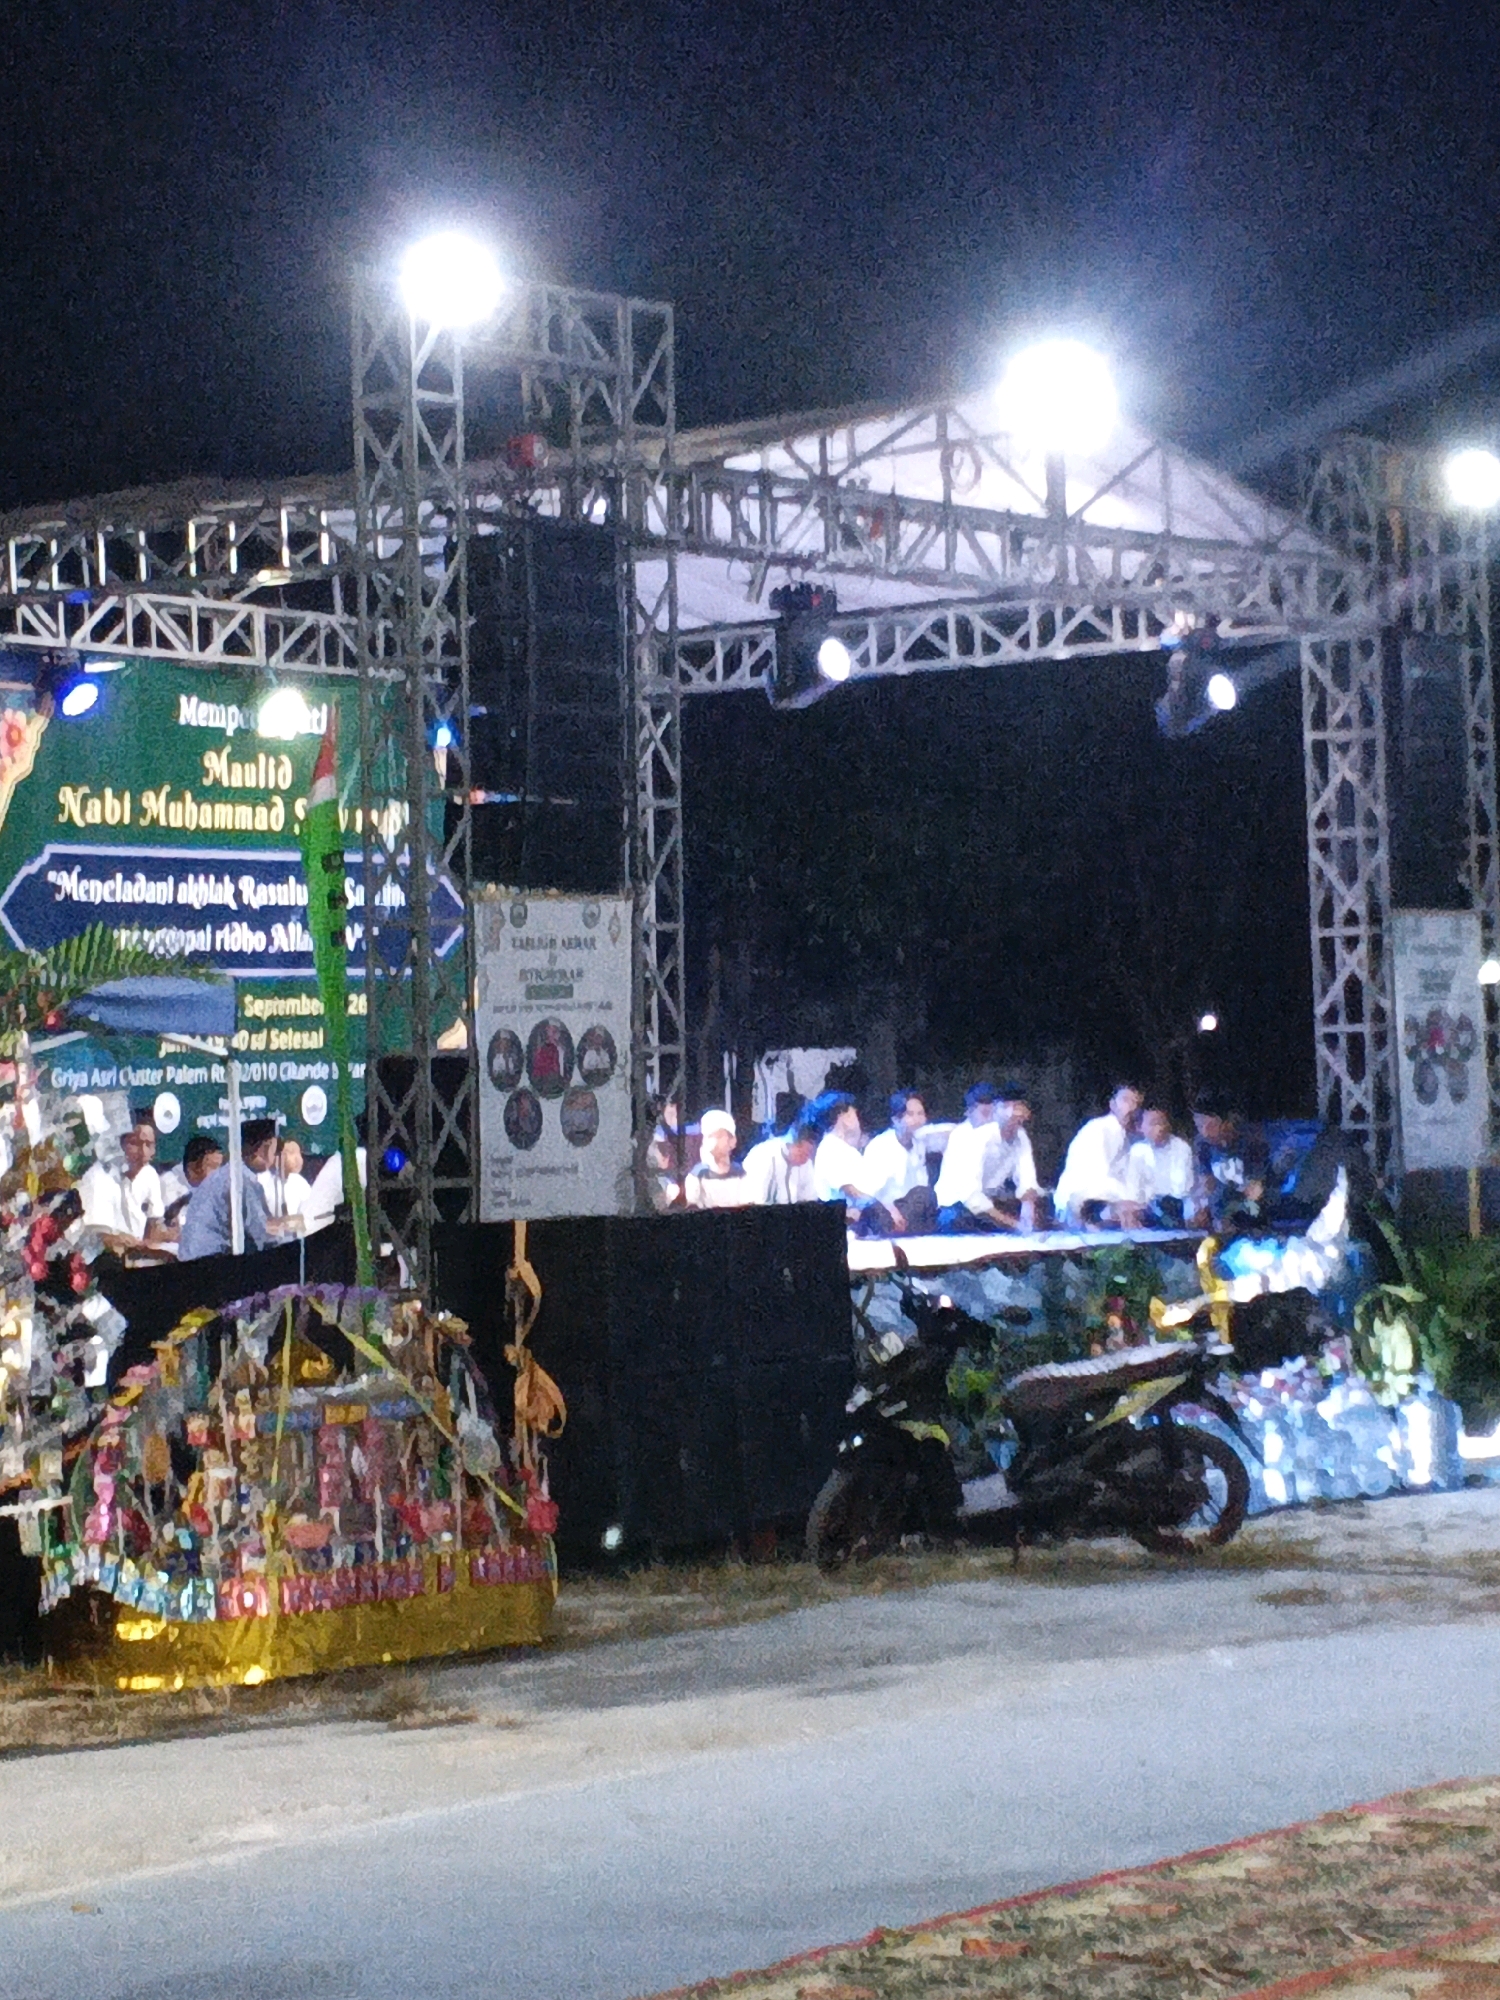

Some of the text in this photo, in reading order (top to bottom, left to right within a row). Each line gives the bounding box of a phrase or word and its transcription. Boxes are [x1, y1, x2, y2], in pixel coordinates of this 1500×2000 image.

[202, 744, 293, 790] Maulid
[58, 785, 131, 828] Nabi
[139, 784, 285, 832] Muhammad
[177, 873, 238, 911] akhlak
[215, 921, 267, 954] ridho
[268, 921, 314, 954] Alla
[269, 1026, 324, 1051] Selesai
[51, 1066, 89, 1093] Griya
[91, 1064, 117, 1087] Asri
[119, 1064, 164, 1087] Cluster
[166, 1063, 208, 1085] Palem
